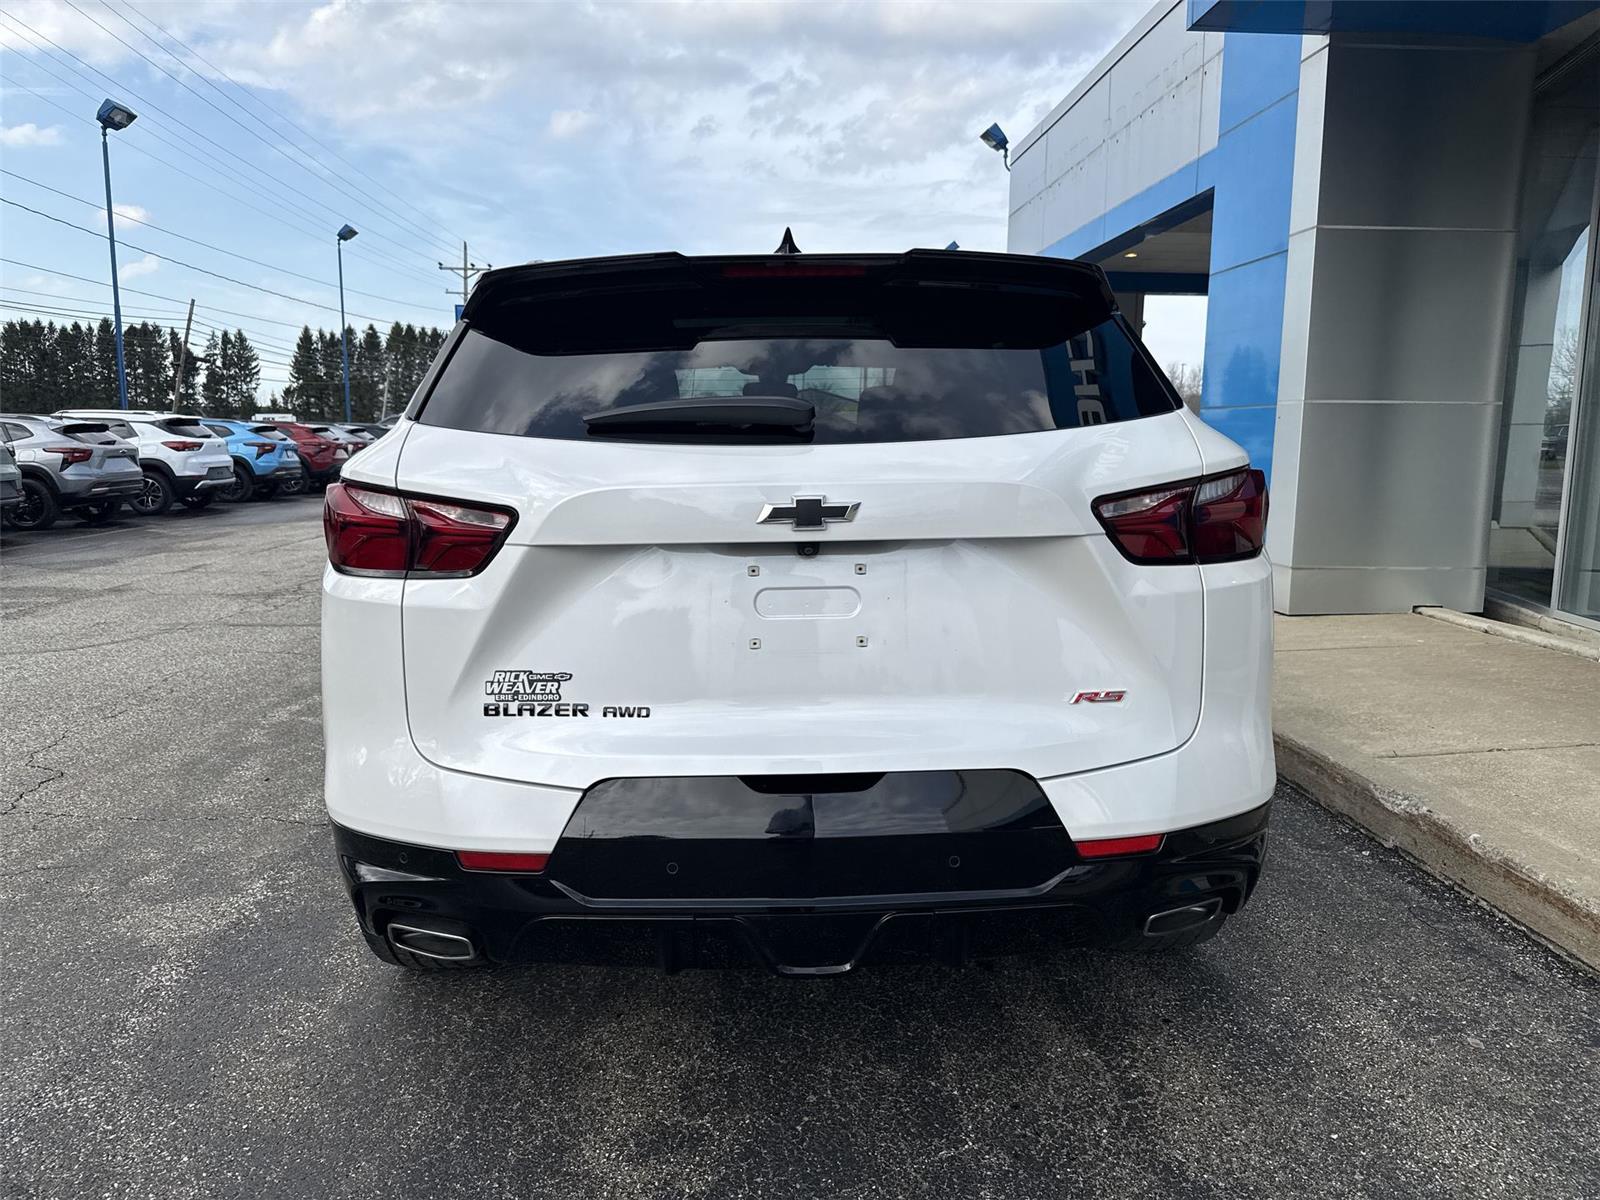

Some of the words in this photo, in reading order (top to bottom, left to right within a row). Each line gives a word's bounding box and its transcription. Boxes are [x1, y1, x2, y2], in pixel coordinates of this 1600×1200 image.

[493, 671, 531, 684] RICK
[485, 681, 560, 694] WEAVER
[1069, 689, 1127, 704] RS
[483, 703, 590, 717] BLAZER
[602, 706, 651, 718] AWD
